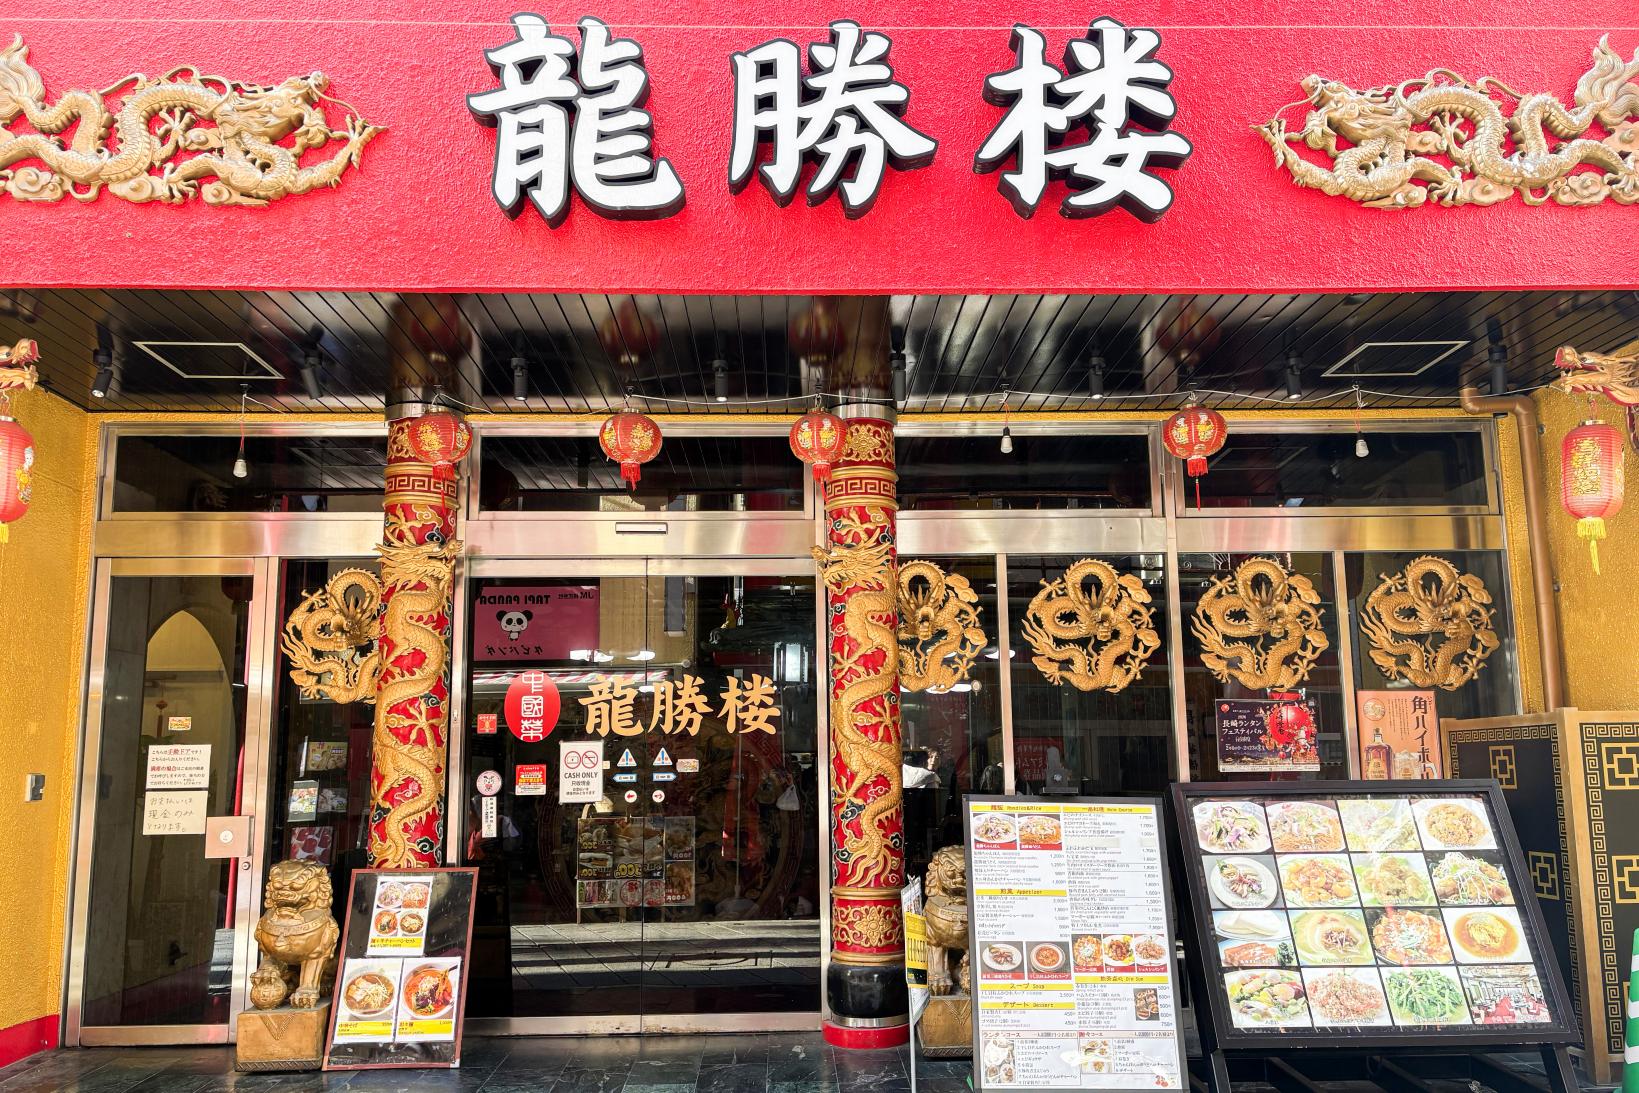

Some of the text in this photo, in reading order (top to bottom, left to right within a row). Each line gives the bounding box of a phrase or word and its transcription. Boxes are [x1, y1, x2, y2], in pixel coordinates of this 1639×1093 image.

[467, 12, 1193, 229] 龍勝楼
[578, 673, 782, 737] 龍勝楼
[582, 771, 598, 779] ONLY
